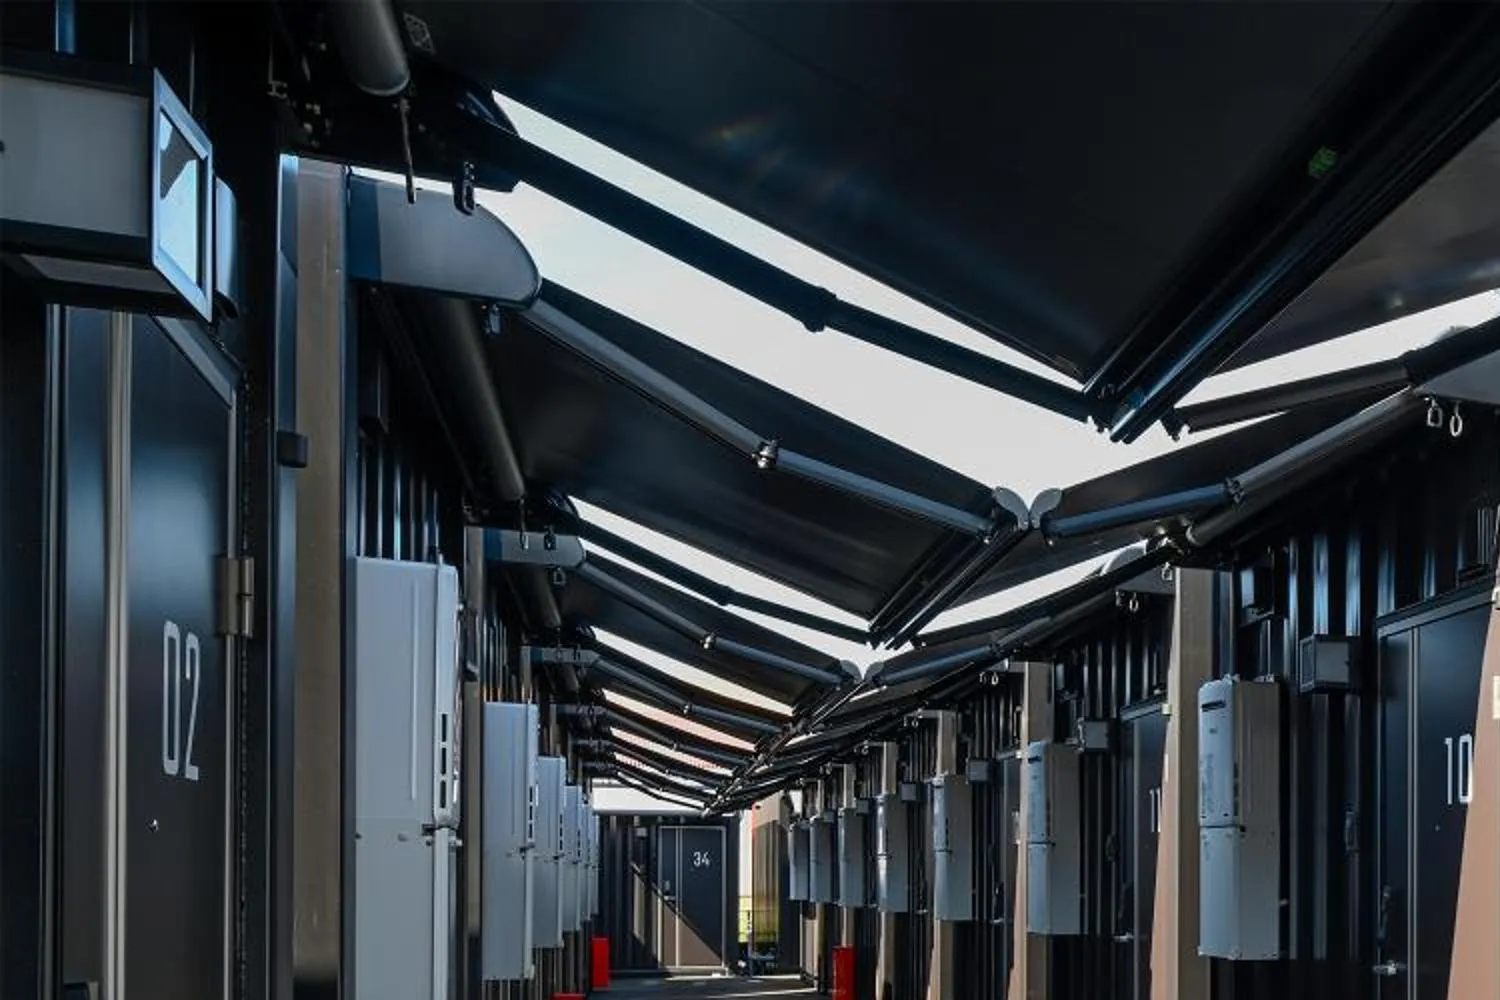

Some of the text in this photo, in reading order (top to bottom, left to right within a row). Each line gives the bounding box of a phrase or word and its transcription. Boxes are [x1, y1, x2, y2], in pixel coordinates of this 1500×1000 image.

[163, 620, 200, 780] 02
[1444, 733, 1473, 805] 10
[693, 851, 710, 866] 34
